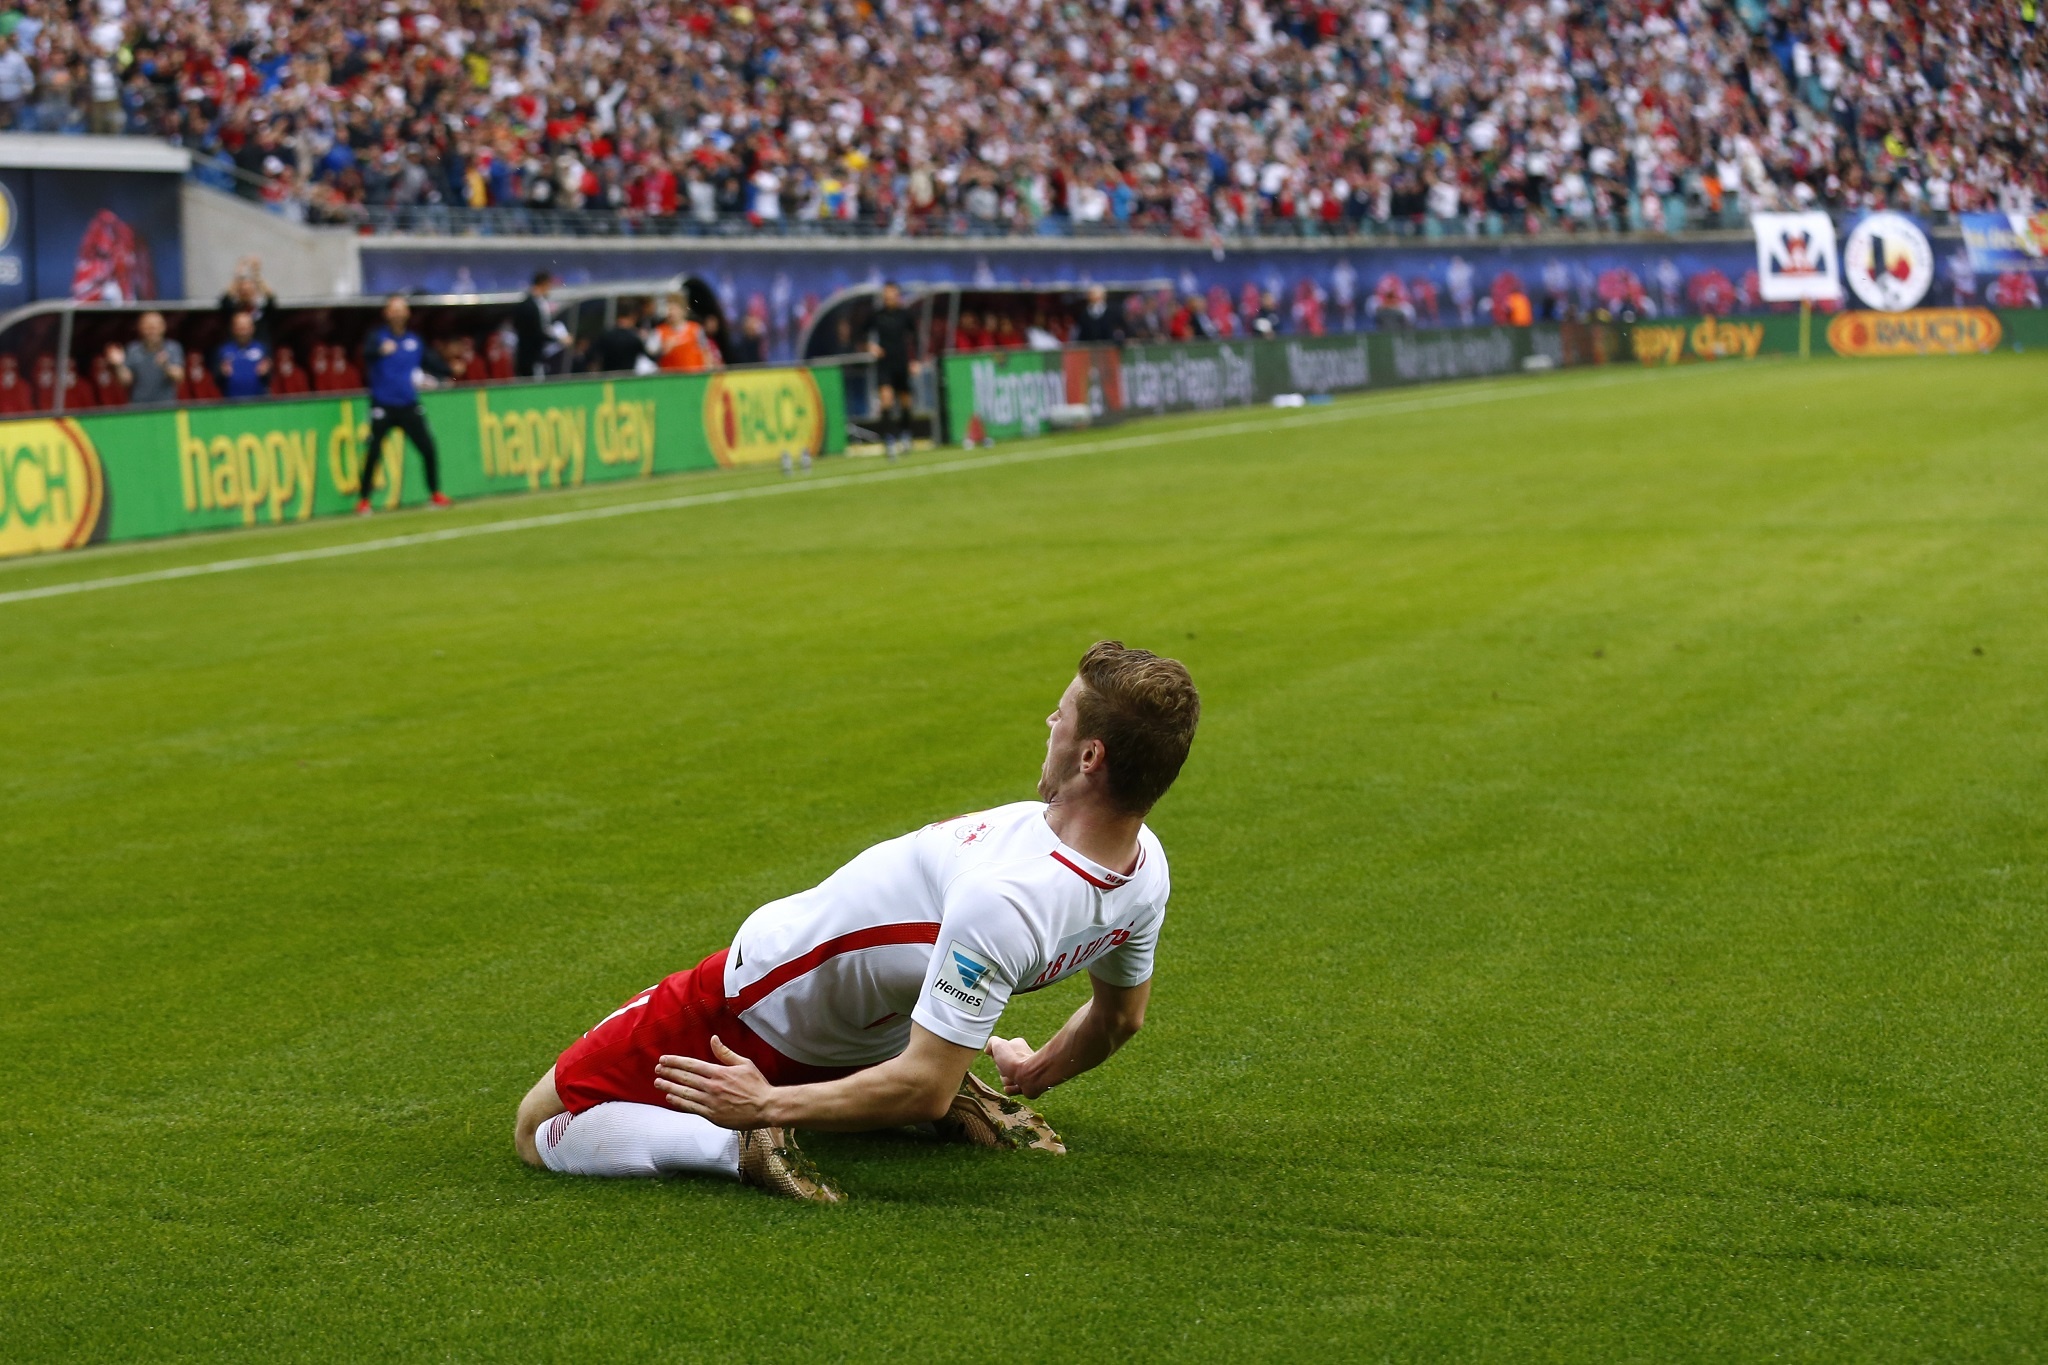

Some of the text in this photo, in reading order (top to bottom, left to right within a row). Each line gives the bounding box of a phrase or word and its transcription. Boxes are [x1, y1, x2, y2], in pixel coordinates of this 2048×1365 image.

[175, 408, 318, 527] happy
[475, 381, 656, 492] happy day
[934, 978, 983, 1007] Hermes
